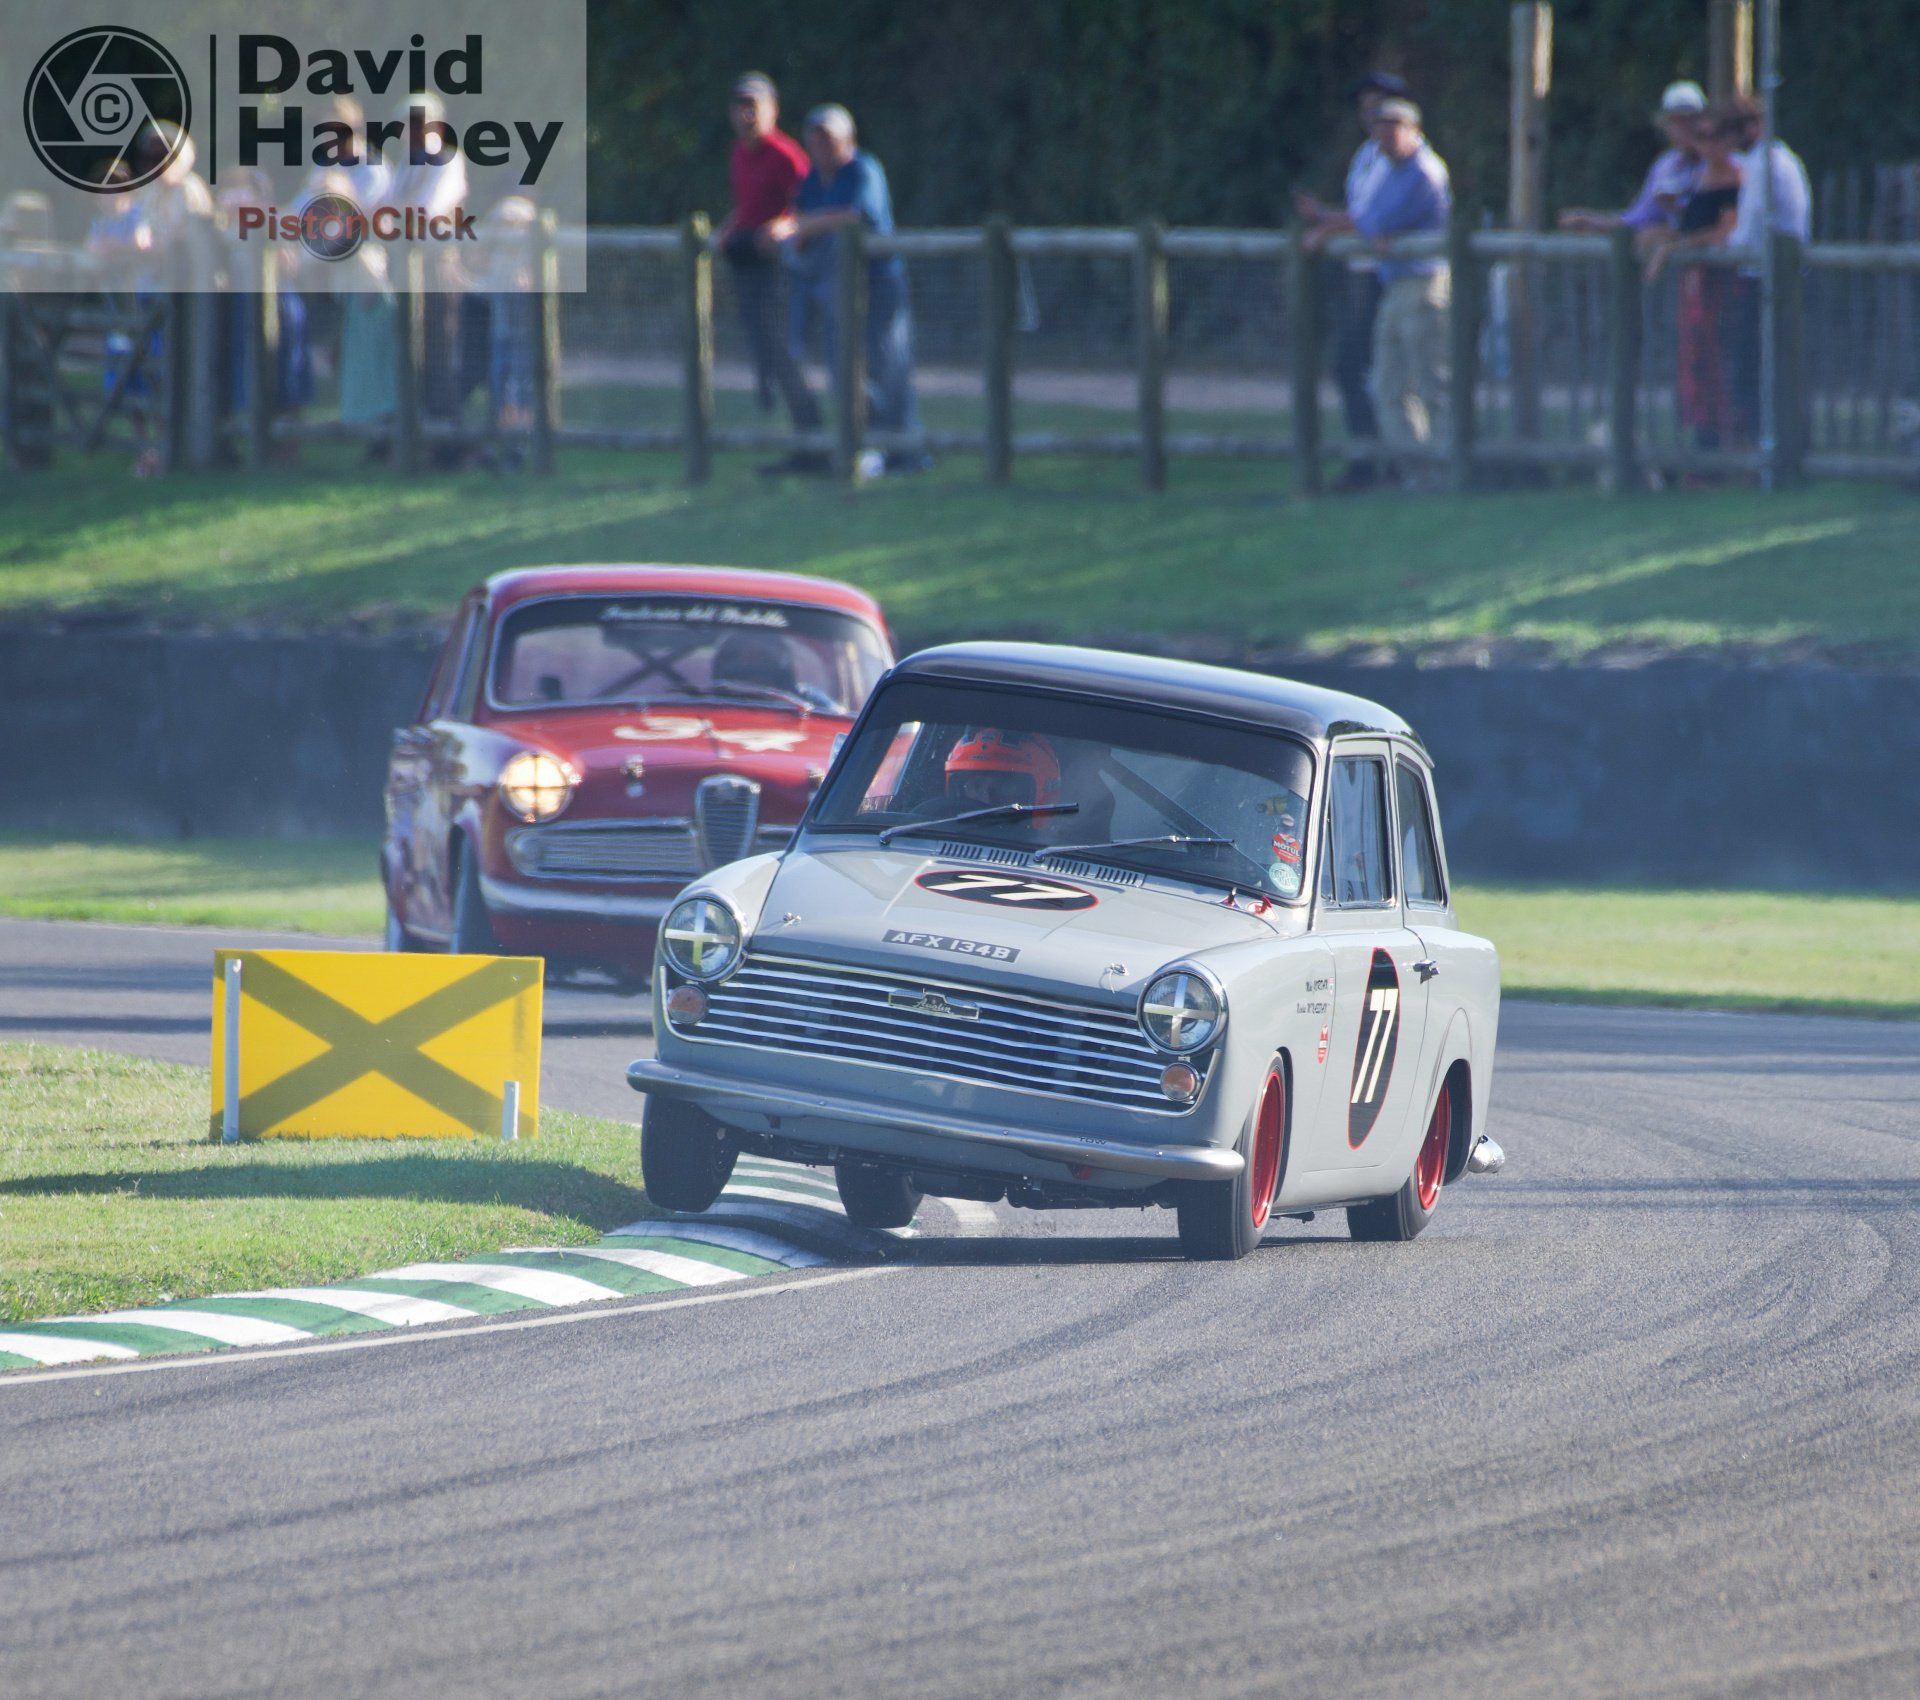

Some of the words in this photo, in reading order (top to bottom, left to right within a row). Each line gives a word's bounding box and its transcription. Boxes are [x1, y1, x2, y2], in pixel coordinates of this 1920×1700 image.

[1273, 840, 1300, 857] MOTUL
[926, 874, 1090, 901] 77
[891, 932, 942, 948] AFX
[949, 938, 1011, 960] 134B
[1350, 988, 1399, 1103] 77
